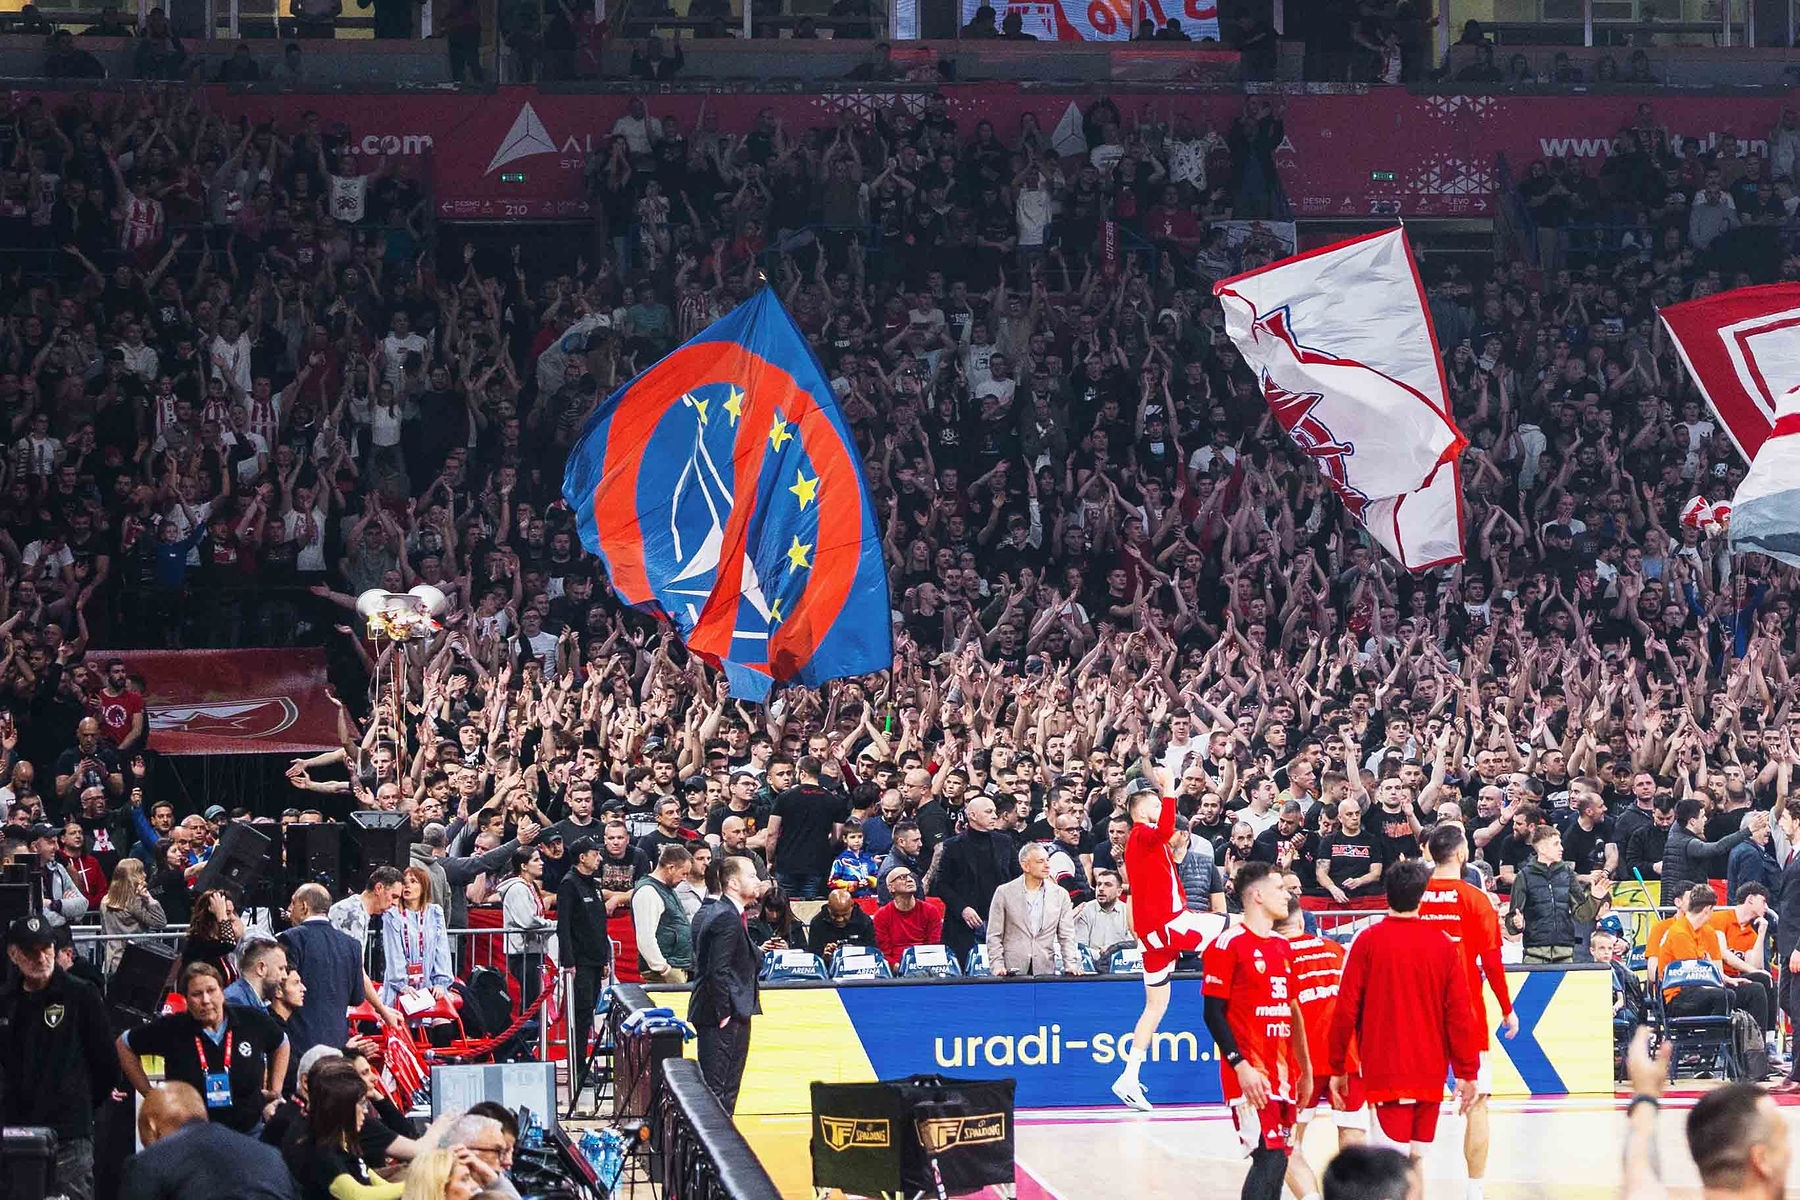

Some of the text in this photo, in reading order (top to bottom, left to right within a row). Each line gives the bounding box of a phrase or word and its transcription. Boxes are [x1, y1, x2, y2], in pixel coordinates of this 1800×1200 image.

[1270, 976, 1288, 999] 36
[855, 1128, 886, 1142] SPALDING
[963, 1123, 1001, 1140] SPALDING
